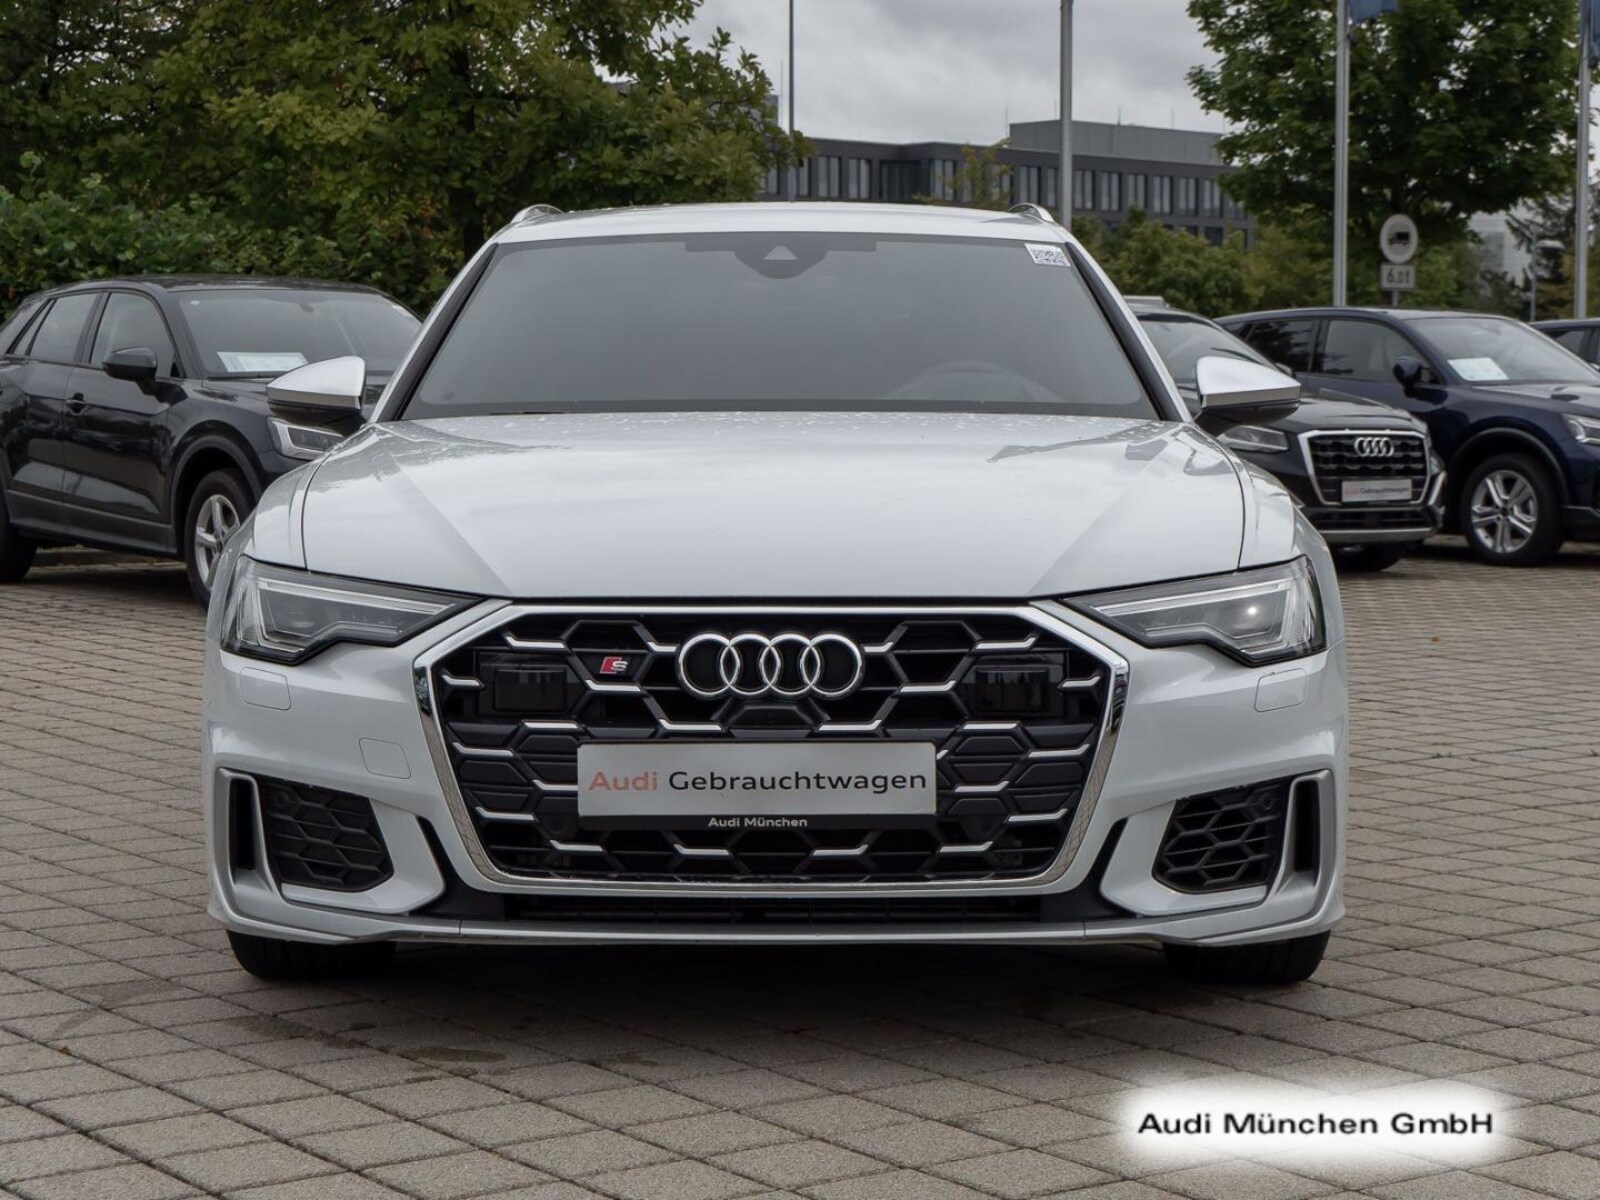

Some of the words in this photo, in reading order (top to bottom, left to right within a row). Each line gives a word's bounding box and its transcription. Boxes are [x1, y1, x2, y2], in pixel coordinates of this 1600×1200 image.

[588, 771, 659, 791] Audi
[668, 771, 927, 795] Gebrauchtwagen
[708, 817, 740, 827] Audi
[743, 817, 808, 828] München
